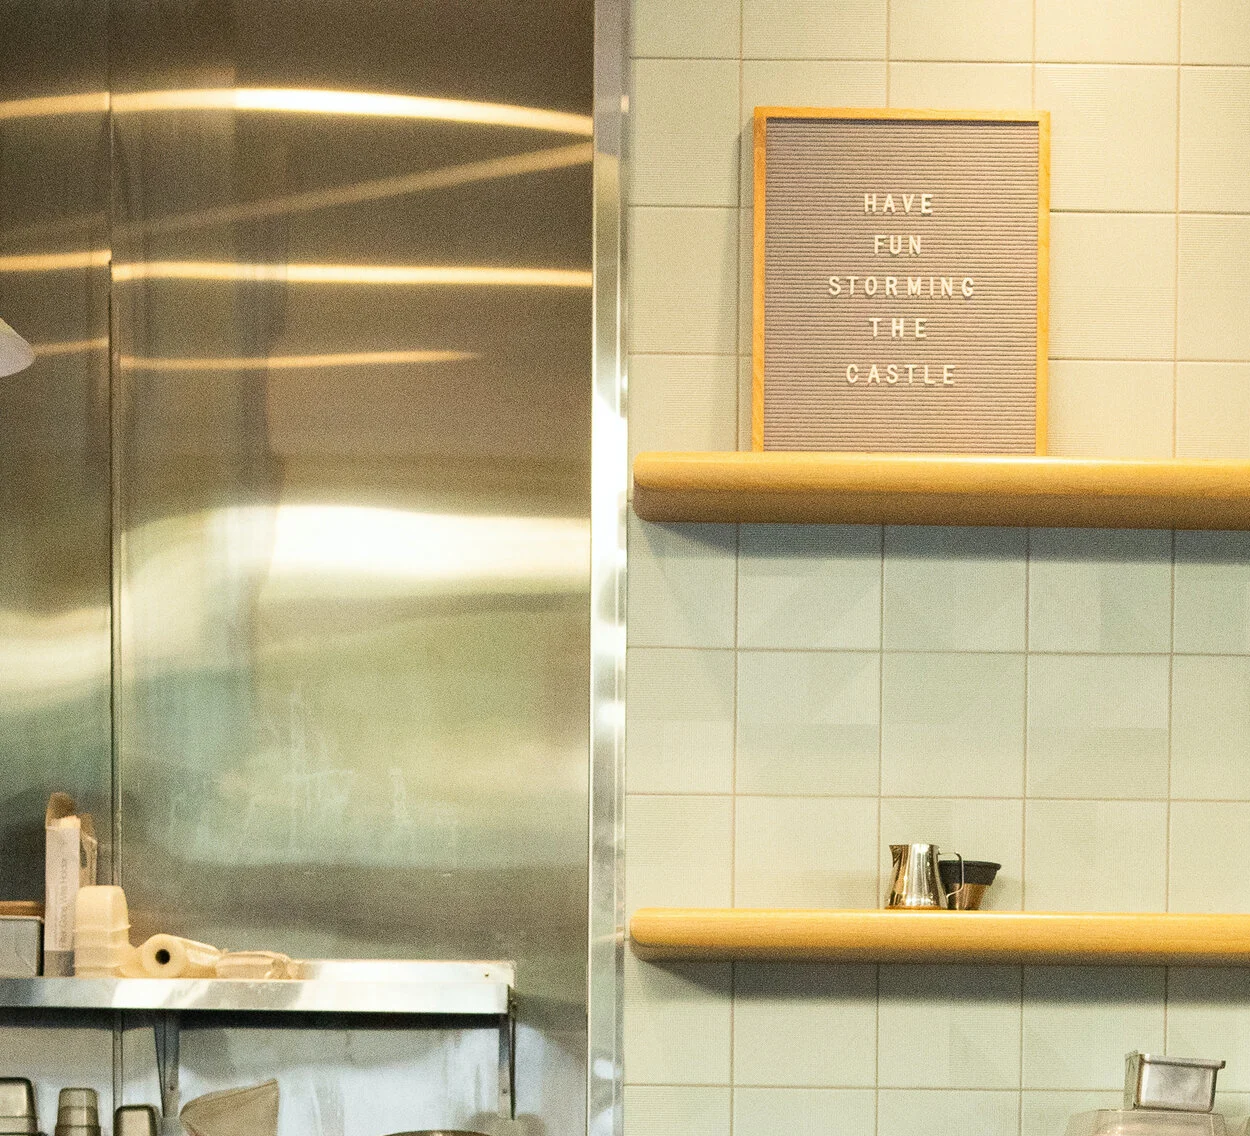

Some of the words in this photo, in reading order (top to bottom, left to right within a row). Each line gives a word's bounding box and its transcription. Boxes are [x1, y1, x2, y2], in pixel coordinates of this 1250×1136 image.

[863, 193, 934, 216] HAVE
[873, 234, 922, 256] FUN
[828, 276, 975, 298] STORMING
[868, 318, 927, 339] THE
[845, 364, 956, 385] CASTLE
